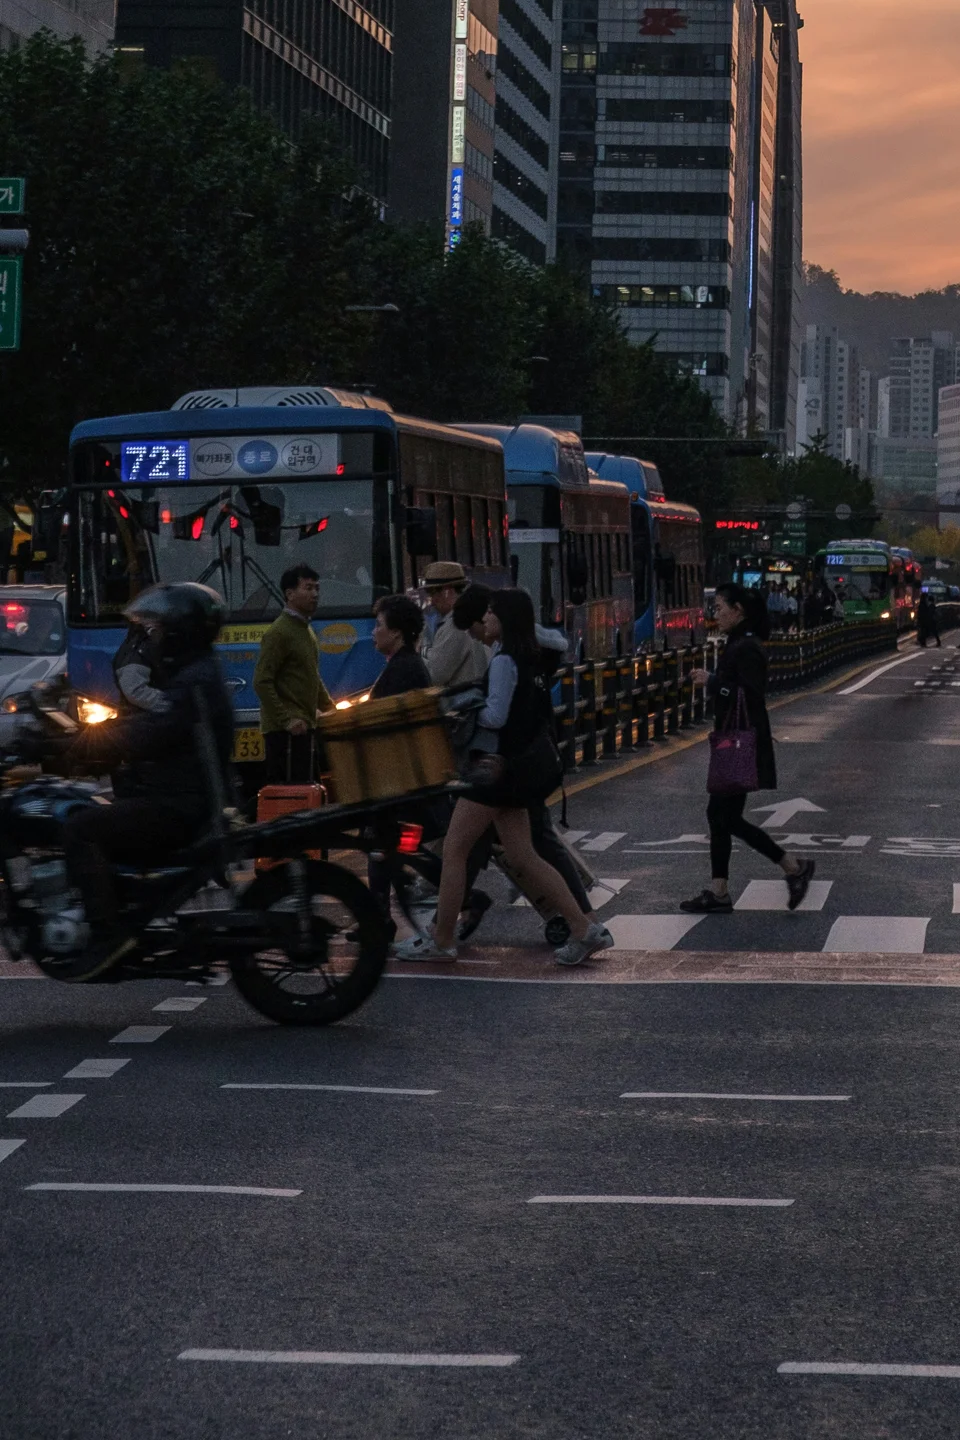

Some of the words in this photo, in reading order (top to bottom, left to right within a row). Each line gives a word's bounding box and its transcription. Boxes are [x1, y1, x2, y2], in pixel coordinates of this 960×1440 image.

[125, 444, 187, 481] 721
[287, 454, 316, 466] 입구역
[826, 554, 844, 565] 7212
